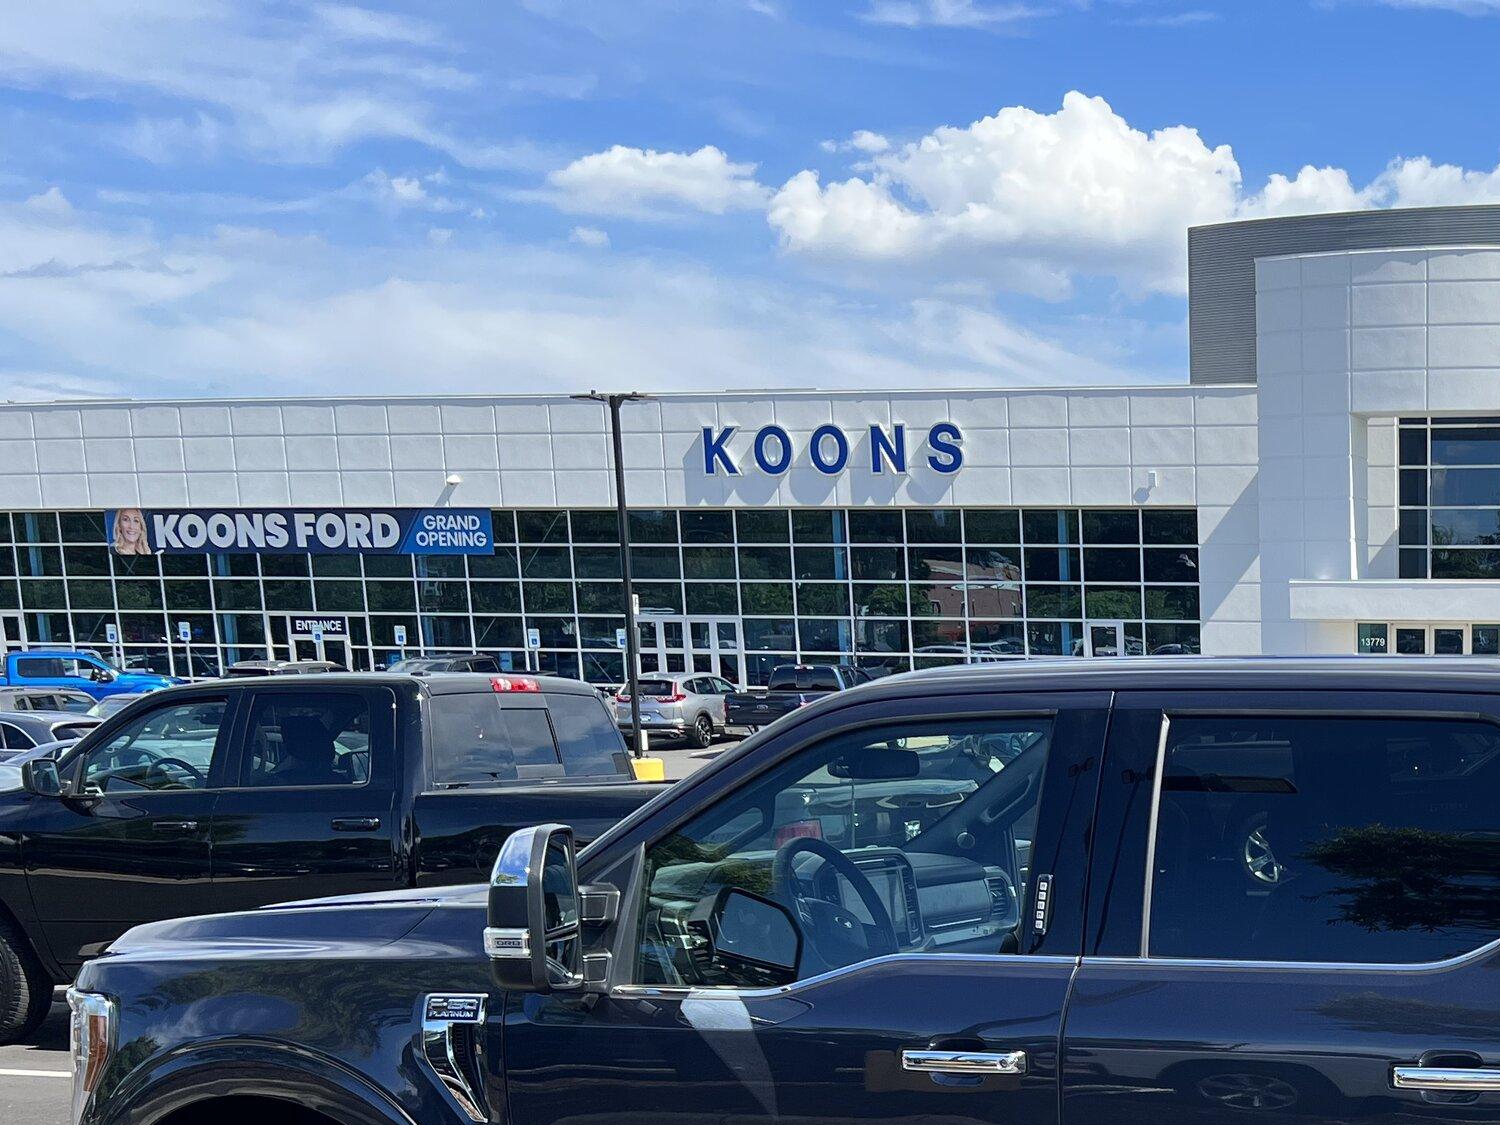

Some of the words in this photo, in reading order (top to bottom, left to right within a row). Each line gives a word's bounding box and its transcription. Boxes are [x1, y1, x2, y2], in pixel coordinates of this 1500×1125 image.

[701, 422, 965, 476] KOONS
[153, 513, 290, 548] KOONS
[294, 513, 400, 548] FORD
[423, 515, 481, 531] GRAND
[415, 531, 488, 547] OPENING
[1360, 637, 1386, 647] 13779
